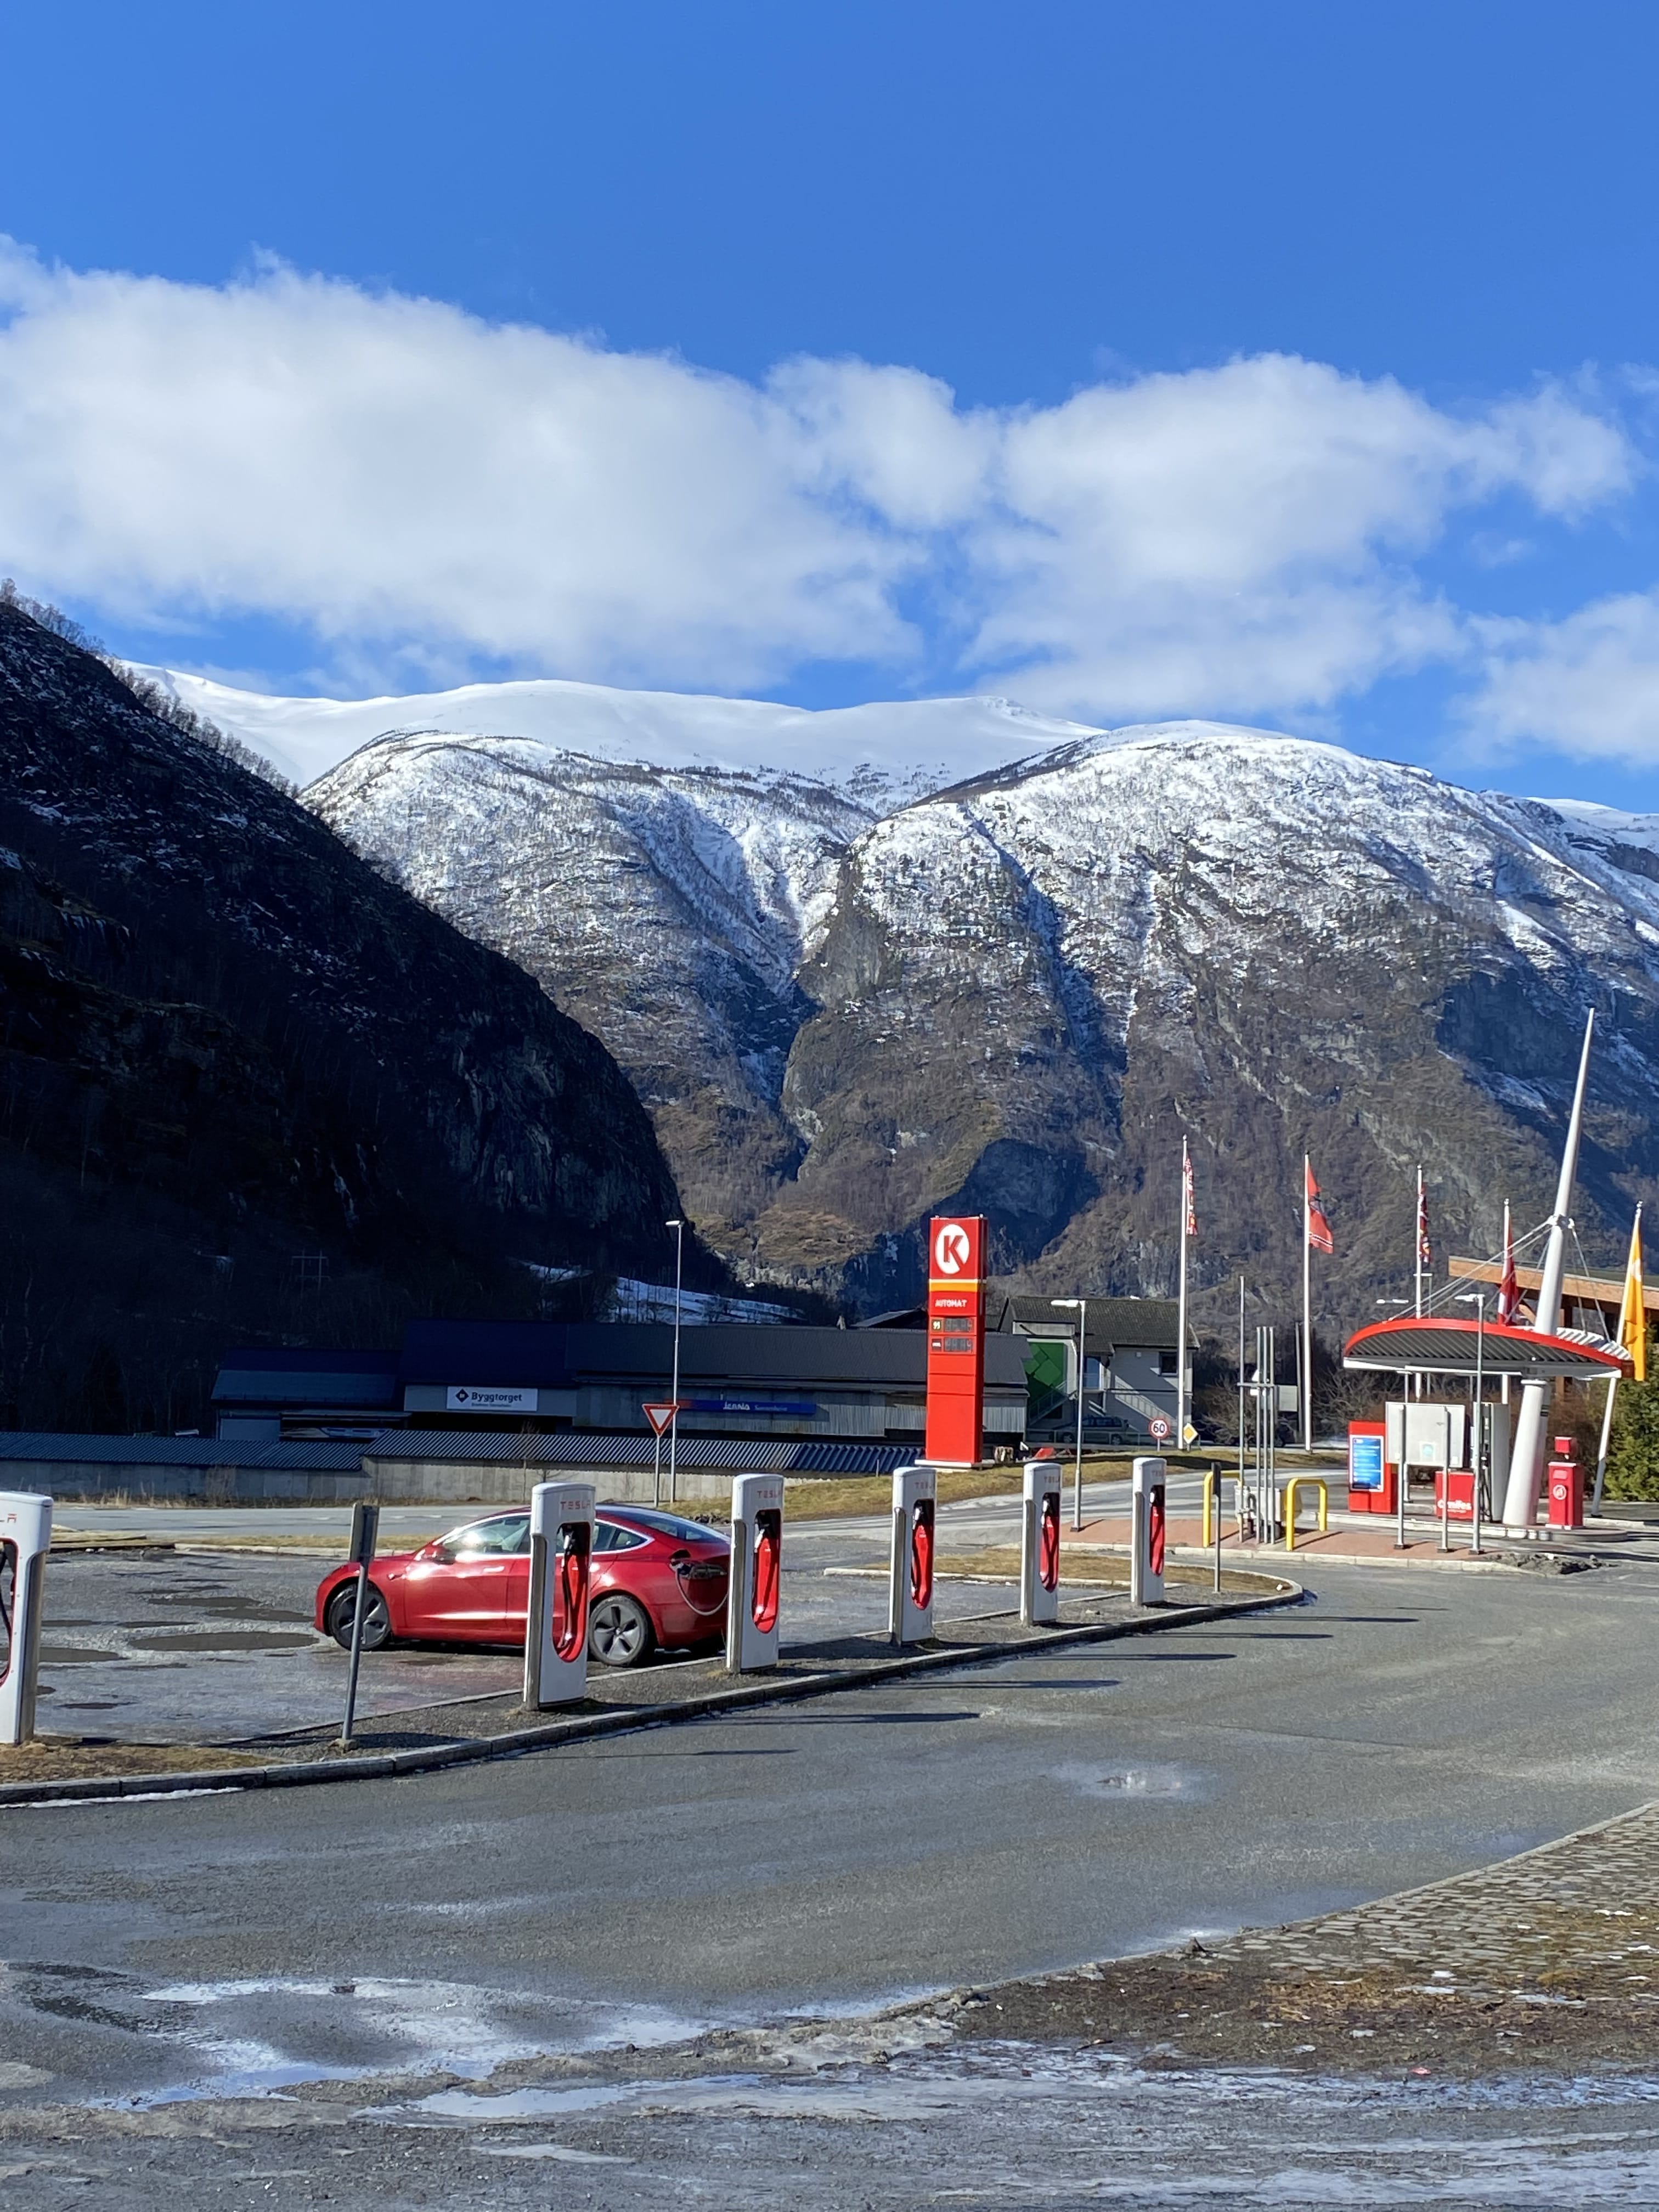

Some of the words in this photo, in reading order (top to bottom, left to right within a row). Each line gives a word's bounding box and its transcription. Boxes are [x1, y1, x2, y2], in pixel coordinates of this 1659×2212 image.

[471, 1392, 522, 1403] Byggtorget
[1153, 1423, 1165, 1433] 60
[560, 1500, 591, 1510] TESLA
